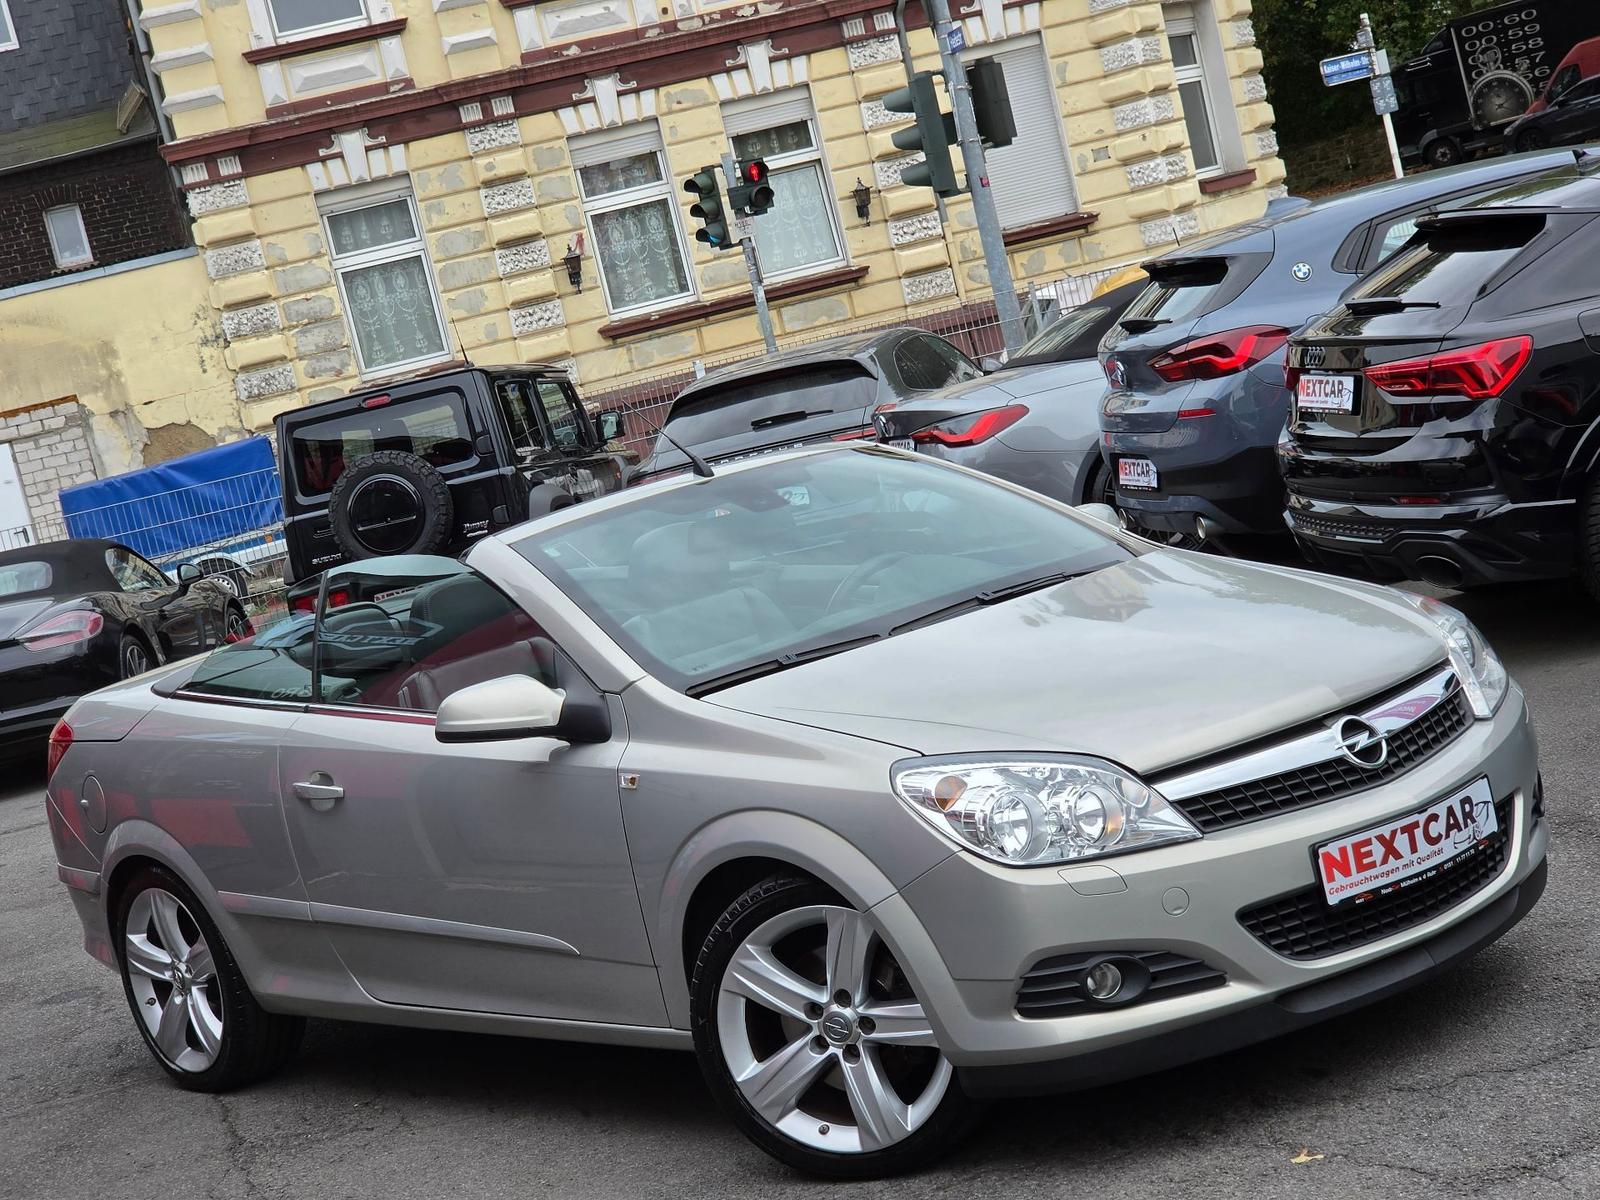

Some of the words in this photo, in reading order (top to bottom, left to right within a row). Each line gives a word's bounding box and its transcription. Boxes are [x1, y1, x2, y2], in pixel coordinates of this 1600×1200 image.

[1461, 9, 1537, 37] 00:60
[1465, 23, 1540, 51] 00:59
[1299, 379, 1345, 399] NEXTCAR
[1119, 460, 1151, 478] NEXTCAR
[312, 552, 343, 565] SUZUKI
[1321, 795, 1478, 884] NEXTCAR
[1328, 866, 1400, 896] Gebrauchtwagen
[1402, 859, 1415, 871] mit
[1416, 846, 1444, 865] Qualität
